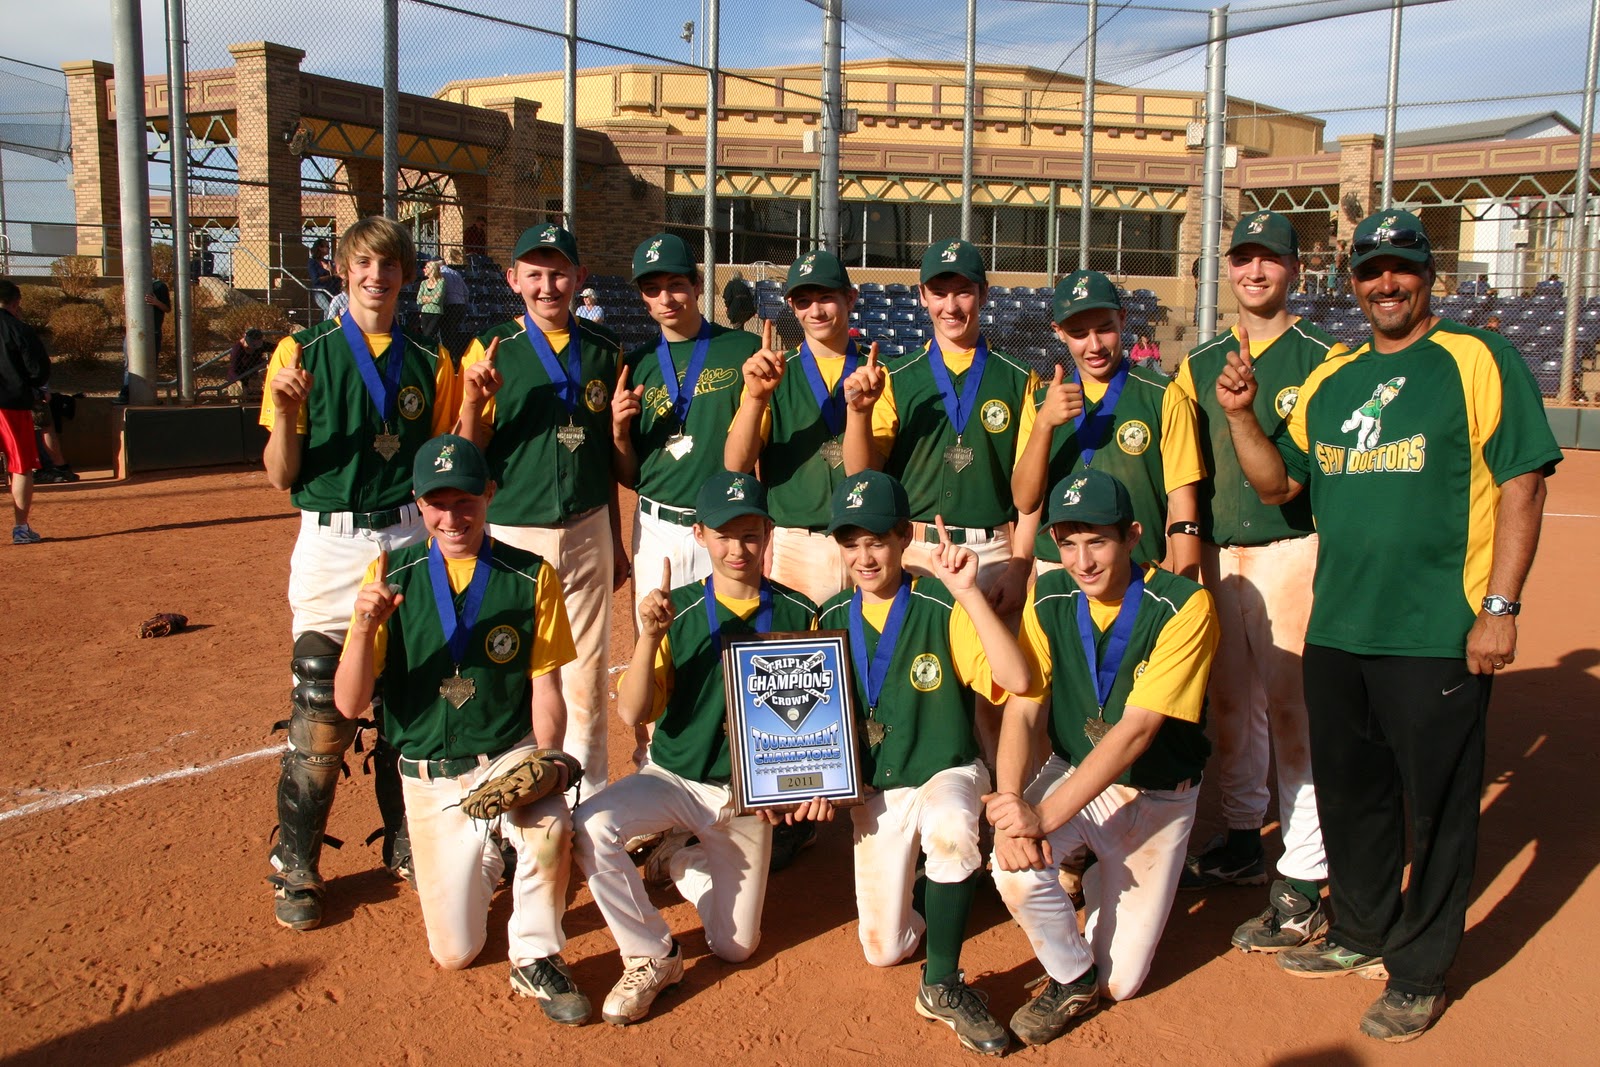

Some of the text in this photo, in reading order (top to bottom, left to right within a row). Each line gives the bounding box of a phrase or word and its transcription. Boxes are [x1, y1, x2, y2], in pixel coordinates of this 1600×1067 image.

[645, 384, 670, 410] Spi
[656, 382, 716, 416] BAALL
[1315, 433, 1426, 475] SPIN DOCTORS
[767, 657, 811, 673] TRIPLE
[748, 671, 832, 692] CHAMPIONS
[771, 693, 811, 706] CROWN
[751, 720, 839, 752] TOURNAMENT
[754, 747, 841, 766] CHAMPIONS
[787, 776, 814, 788] 2011
